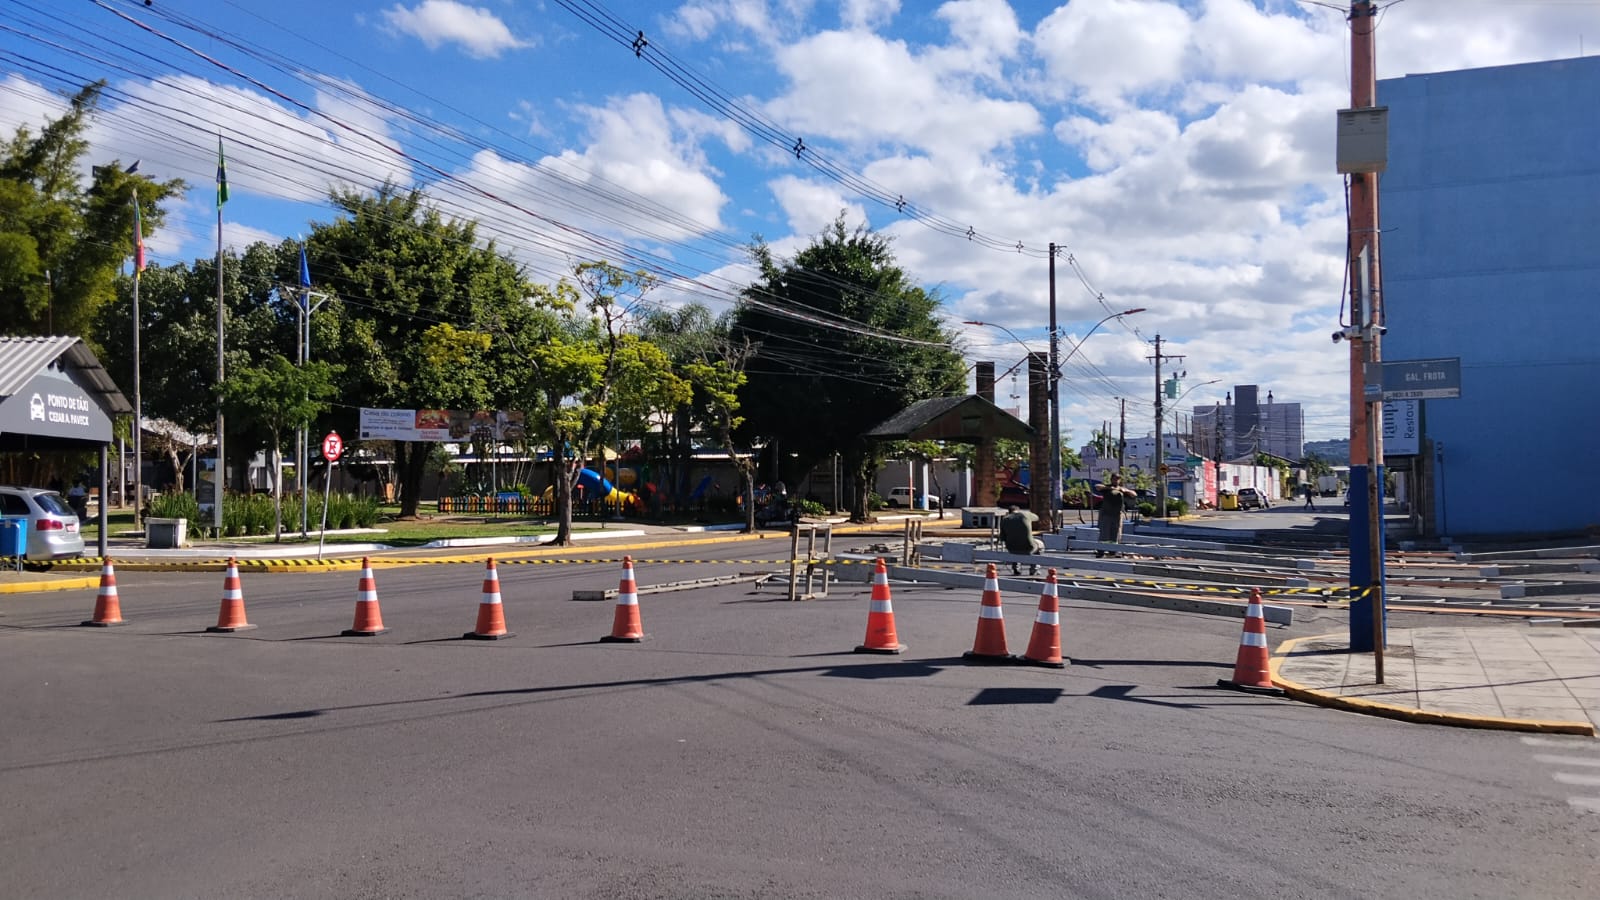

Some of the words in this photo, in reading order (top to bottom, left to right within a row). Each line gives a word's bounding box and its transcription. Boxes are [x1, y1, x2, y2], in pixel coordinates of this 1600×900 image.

[1424, 371, 1446, 381] FROTA
[48, 394, 68, 408] PONTO
[68, 397, 76, 410] DE
[76, 396, 89, 412] TÁXI
